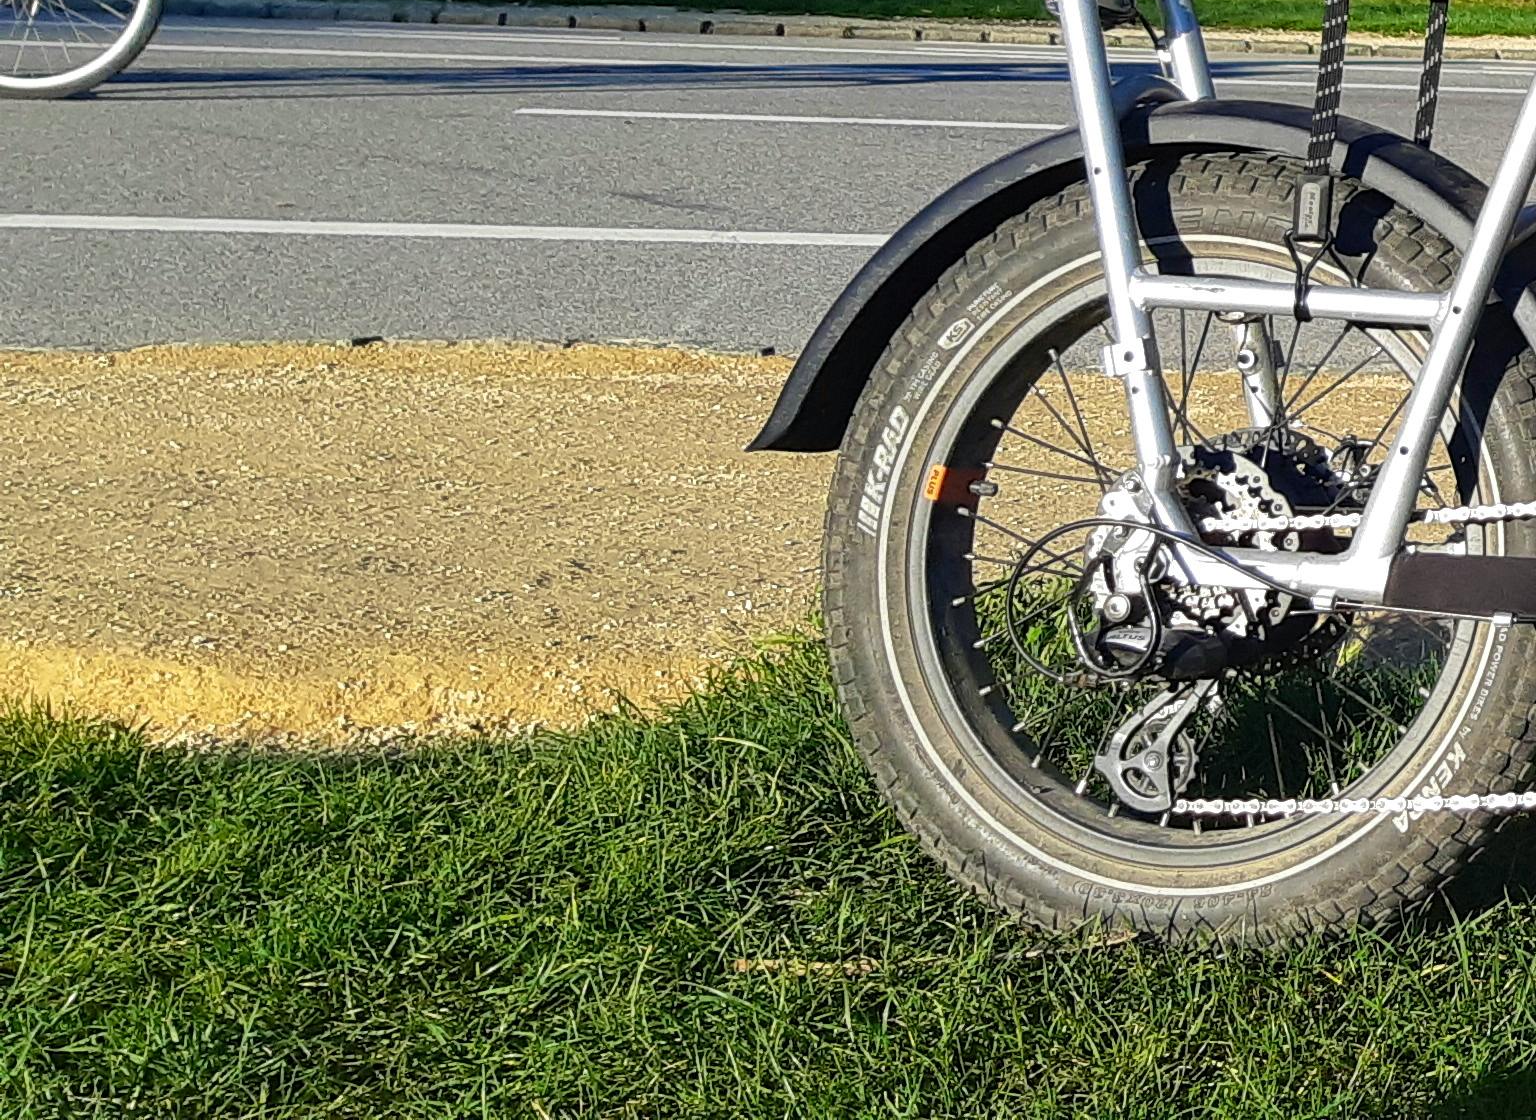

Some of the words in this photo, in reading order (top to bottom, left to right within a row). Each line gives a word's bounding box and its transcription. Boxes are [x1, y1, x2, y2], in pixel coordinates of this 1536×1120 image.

[863, 404, 911, 504] K-RAD
[926, 468, 940, 496] PLUS
[1483, 645, 1505, 687] POWER
